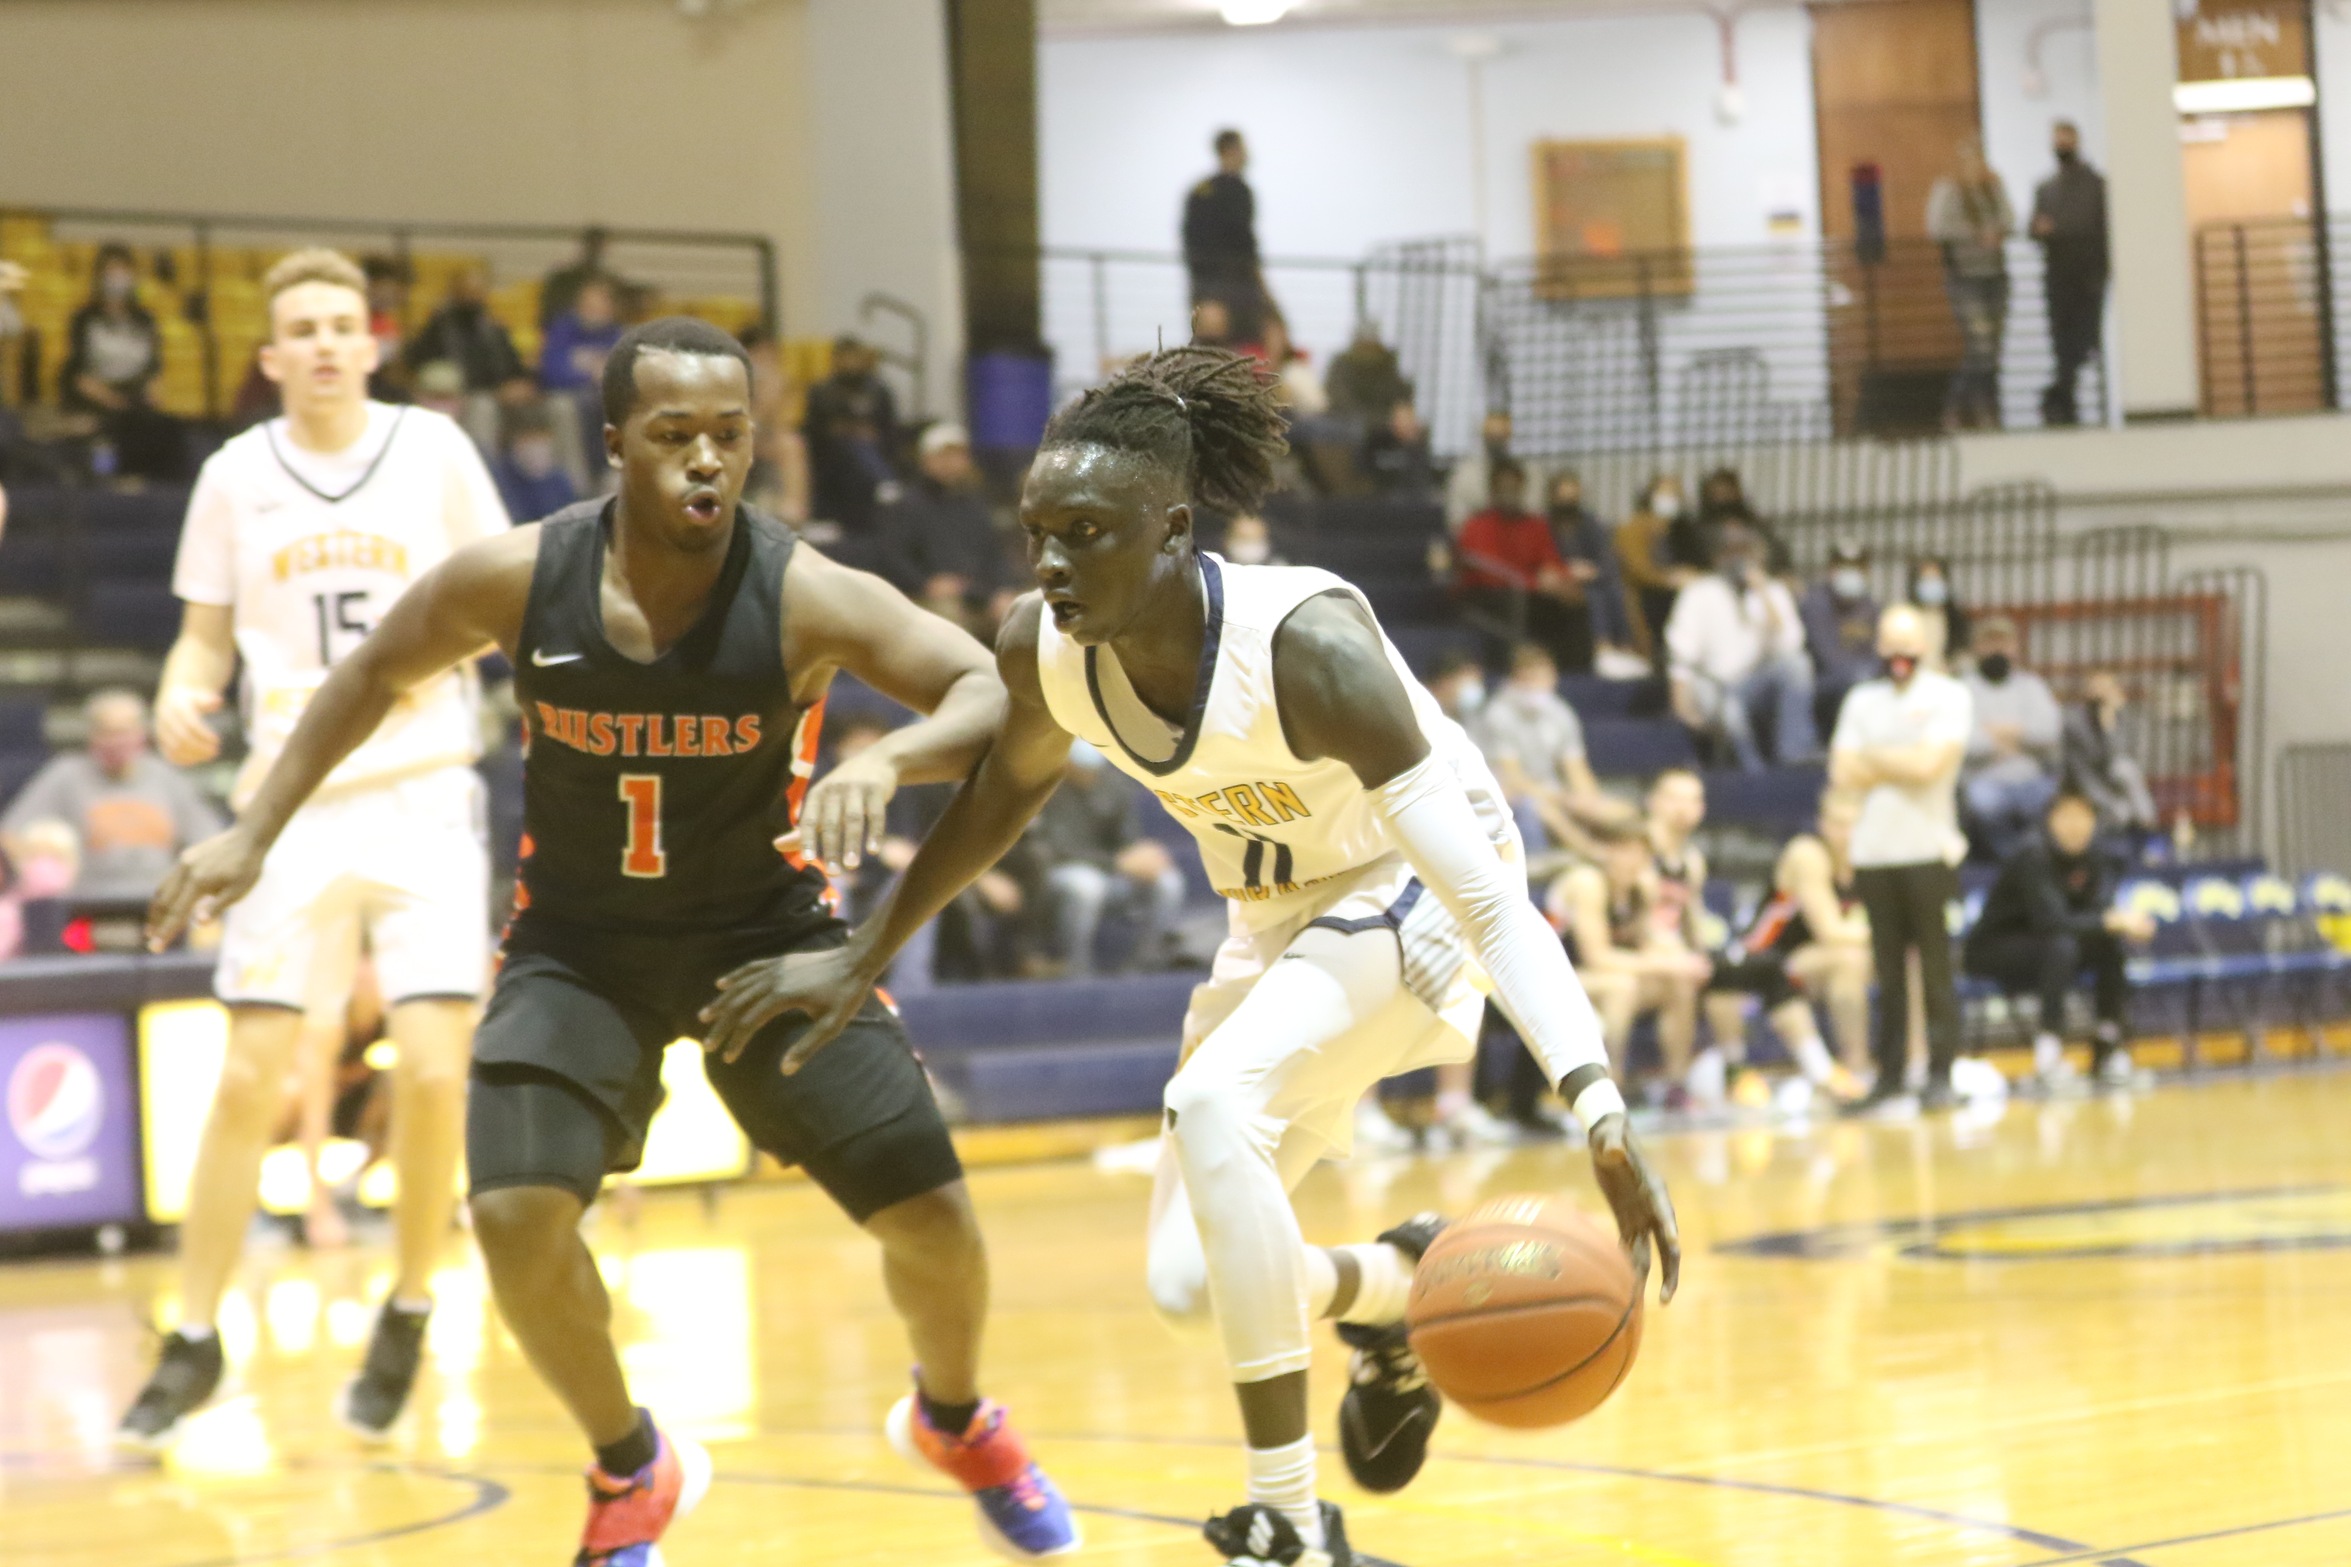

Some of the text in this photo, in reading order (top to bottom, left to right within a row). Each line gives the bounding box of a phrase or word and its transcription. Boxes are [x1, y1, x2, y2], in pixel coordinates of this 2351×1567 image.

[313, 590, 372, 667] 15
[536, 701, 762, 757] RUSTLERS
[618, 774, 666, 878] 1
